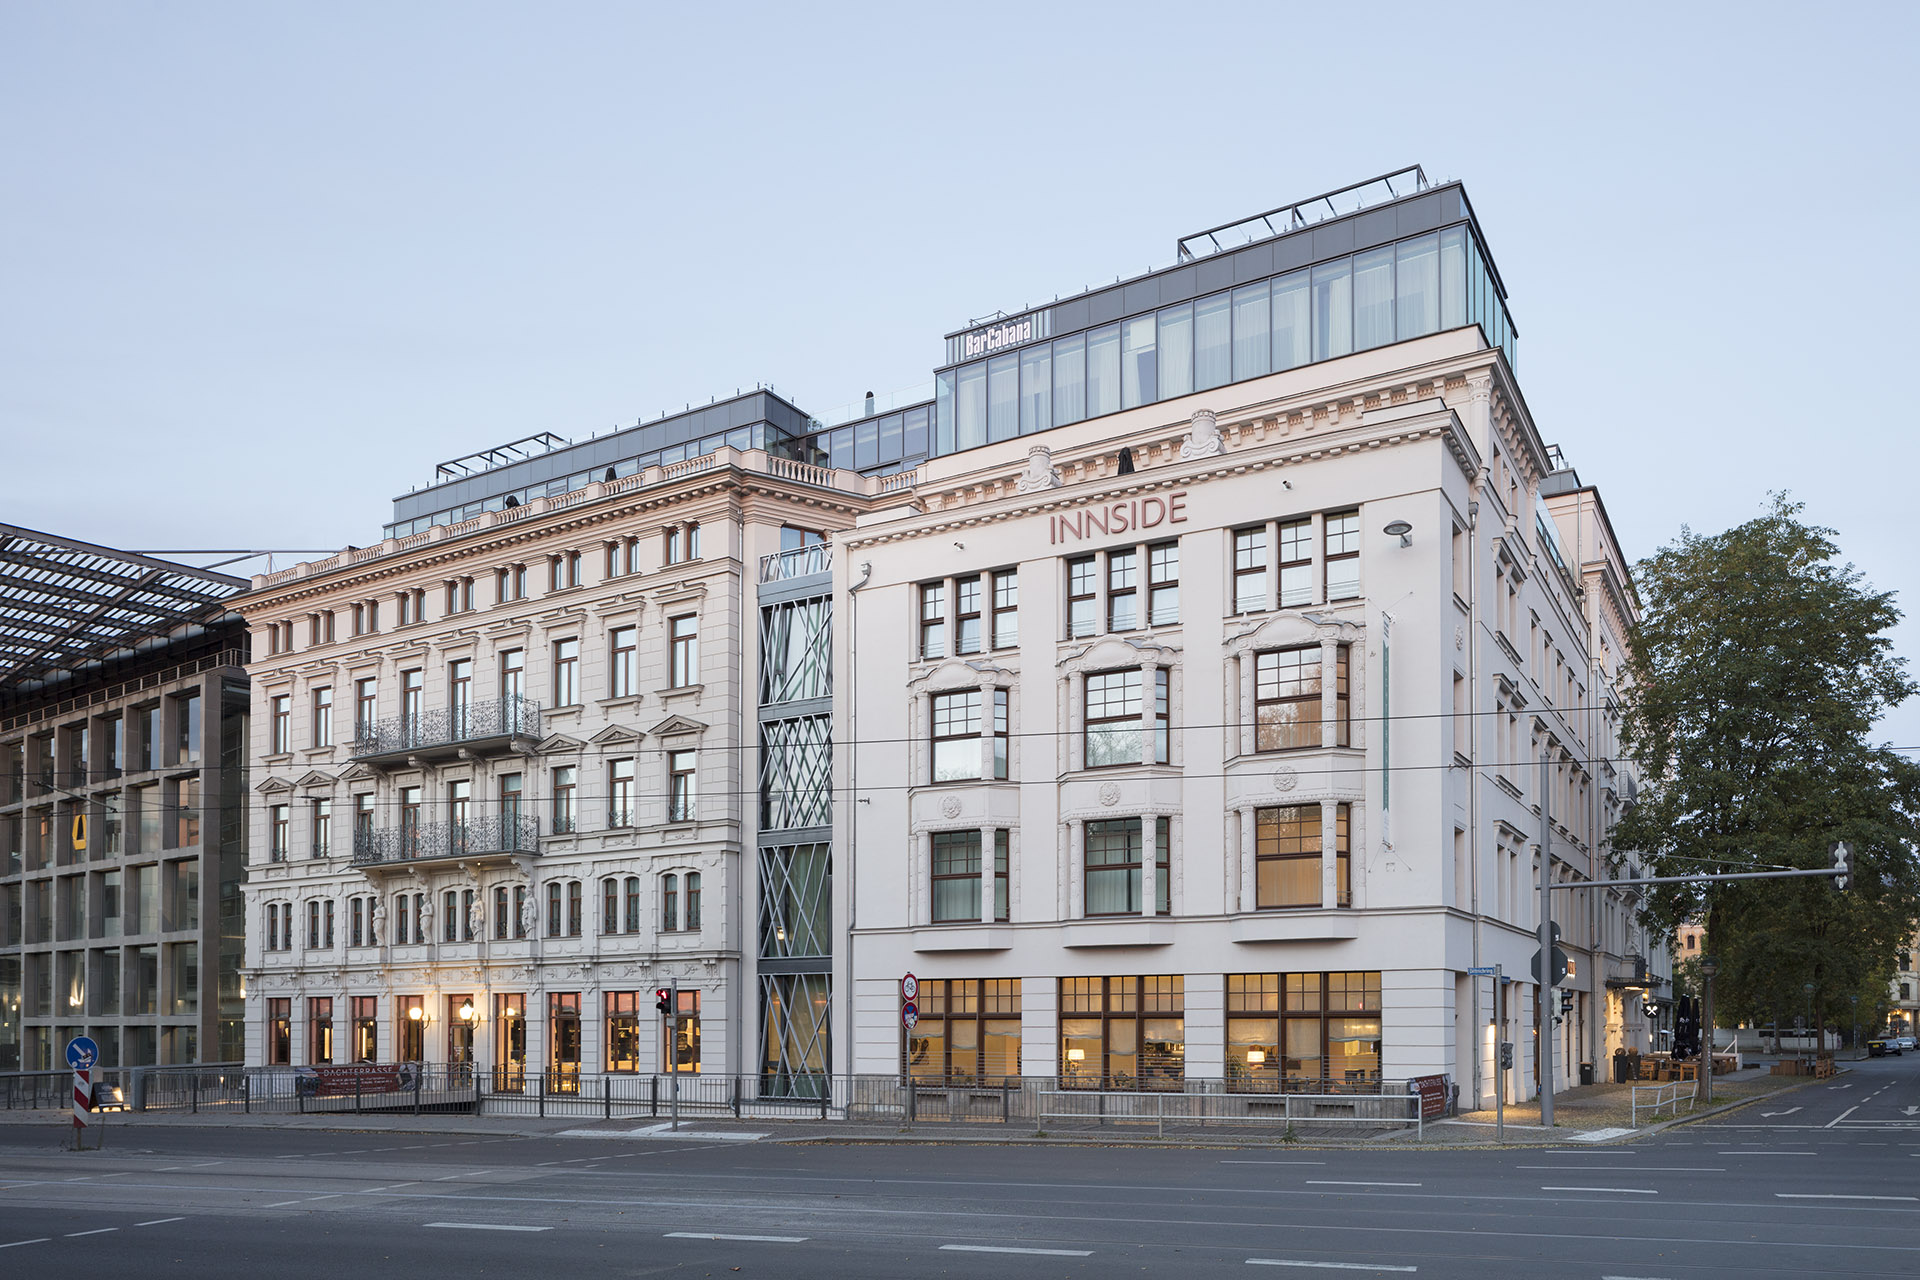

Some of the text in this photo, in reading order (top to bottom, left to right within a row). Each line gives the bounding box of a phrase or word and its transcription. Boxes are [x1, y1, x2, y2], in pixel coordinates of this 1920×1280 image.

[965, 321, 1031, 356] BarCabana
[1050, 491, 1188, 544] INNSIDE
[323, 1067, 393, 1077] DACHTERRASSE
